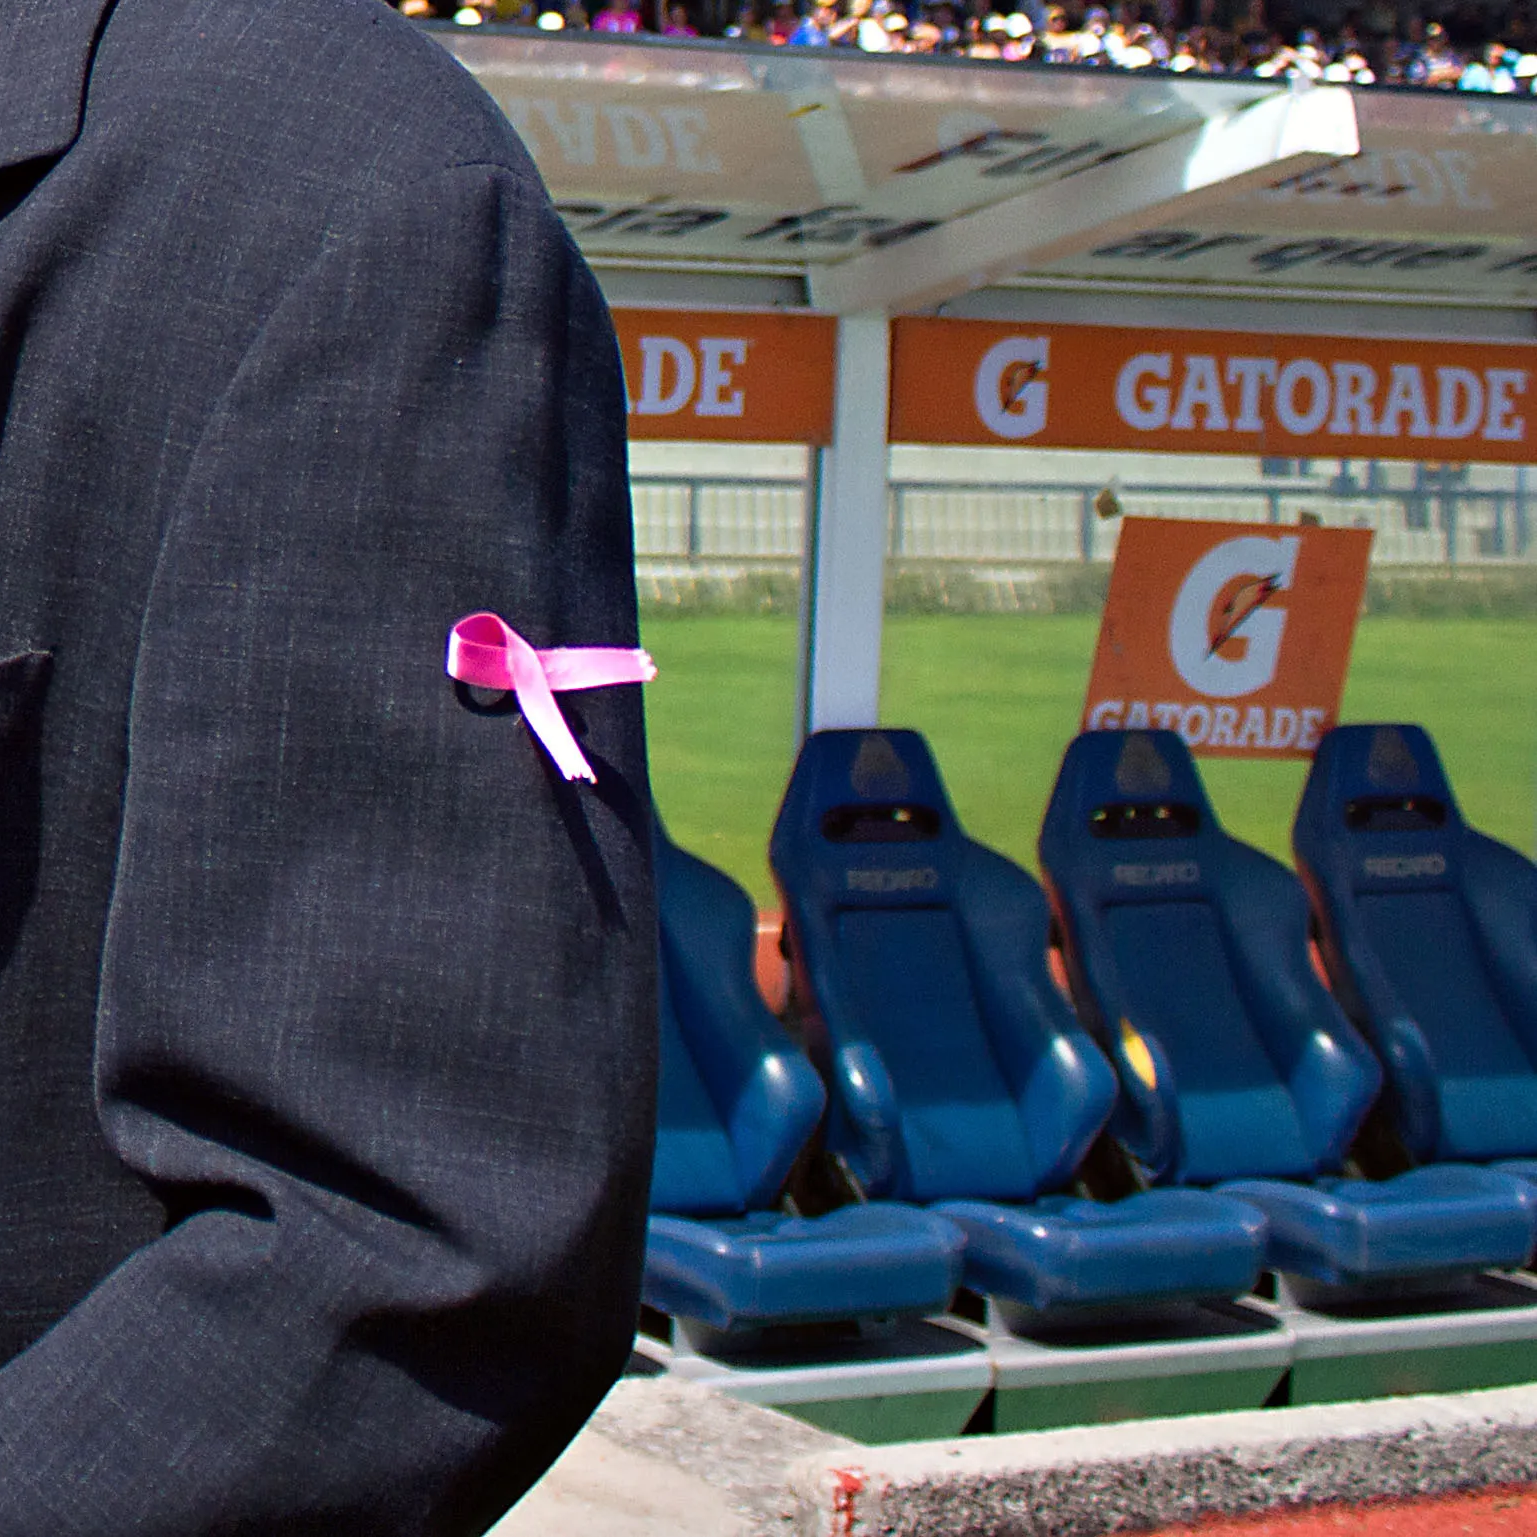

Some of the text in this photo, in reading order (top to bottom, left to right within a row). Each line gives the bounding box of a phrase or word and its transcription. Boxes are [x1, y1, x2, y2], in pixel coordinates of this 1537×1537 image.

[630, 335, 748, 418] DE
[974, 335, 1528, 442] G GATORADE
[1169, 535, 1303, 698] G
